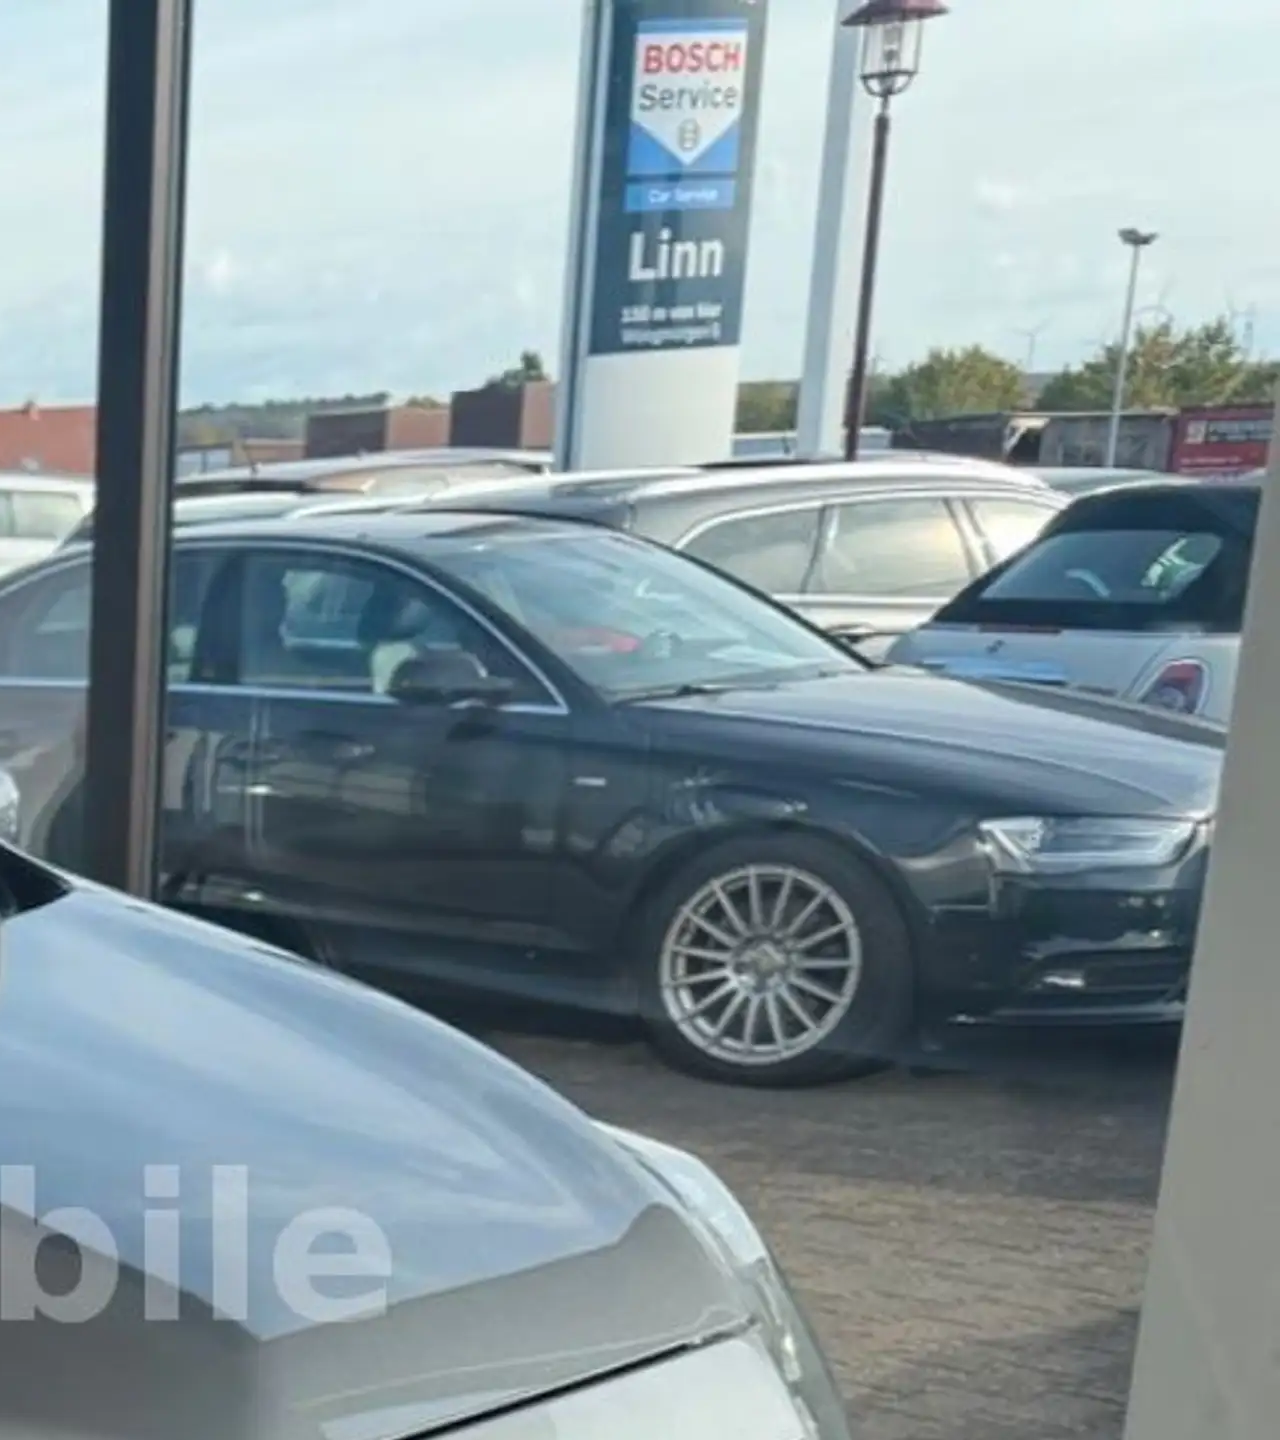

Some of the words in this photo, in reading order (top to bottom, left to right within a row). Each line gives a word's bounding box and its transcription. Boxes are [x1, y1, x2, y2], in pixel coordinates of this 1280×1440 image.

[643, 41, 742, 74] BOSCH
[638, 79, 739, 112] Service
[627, 227, 725, 281] Linn
